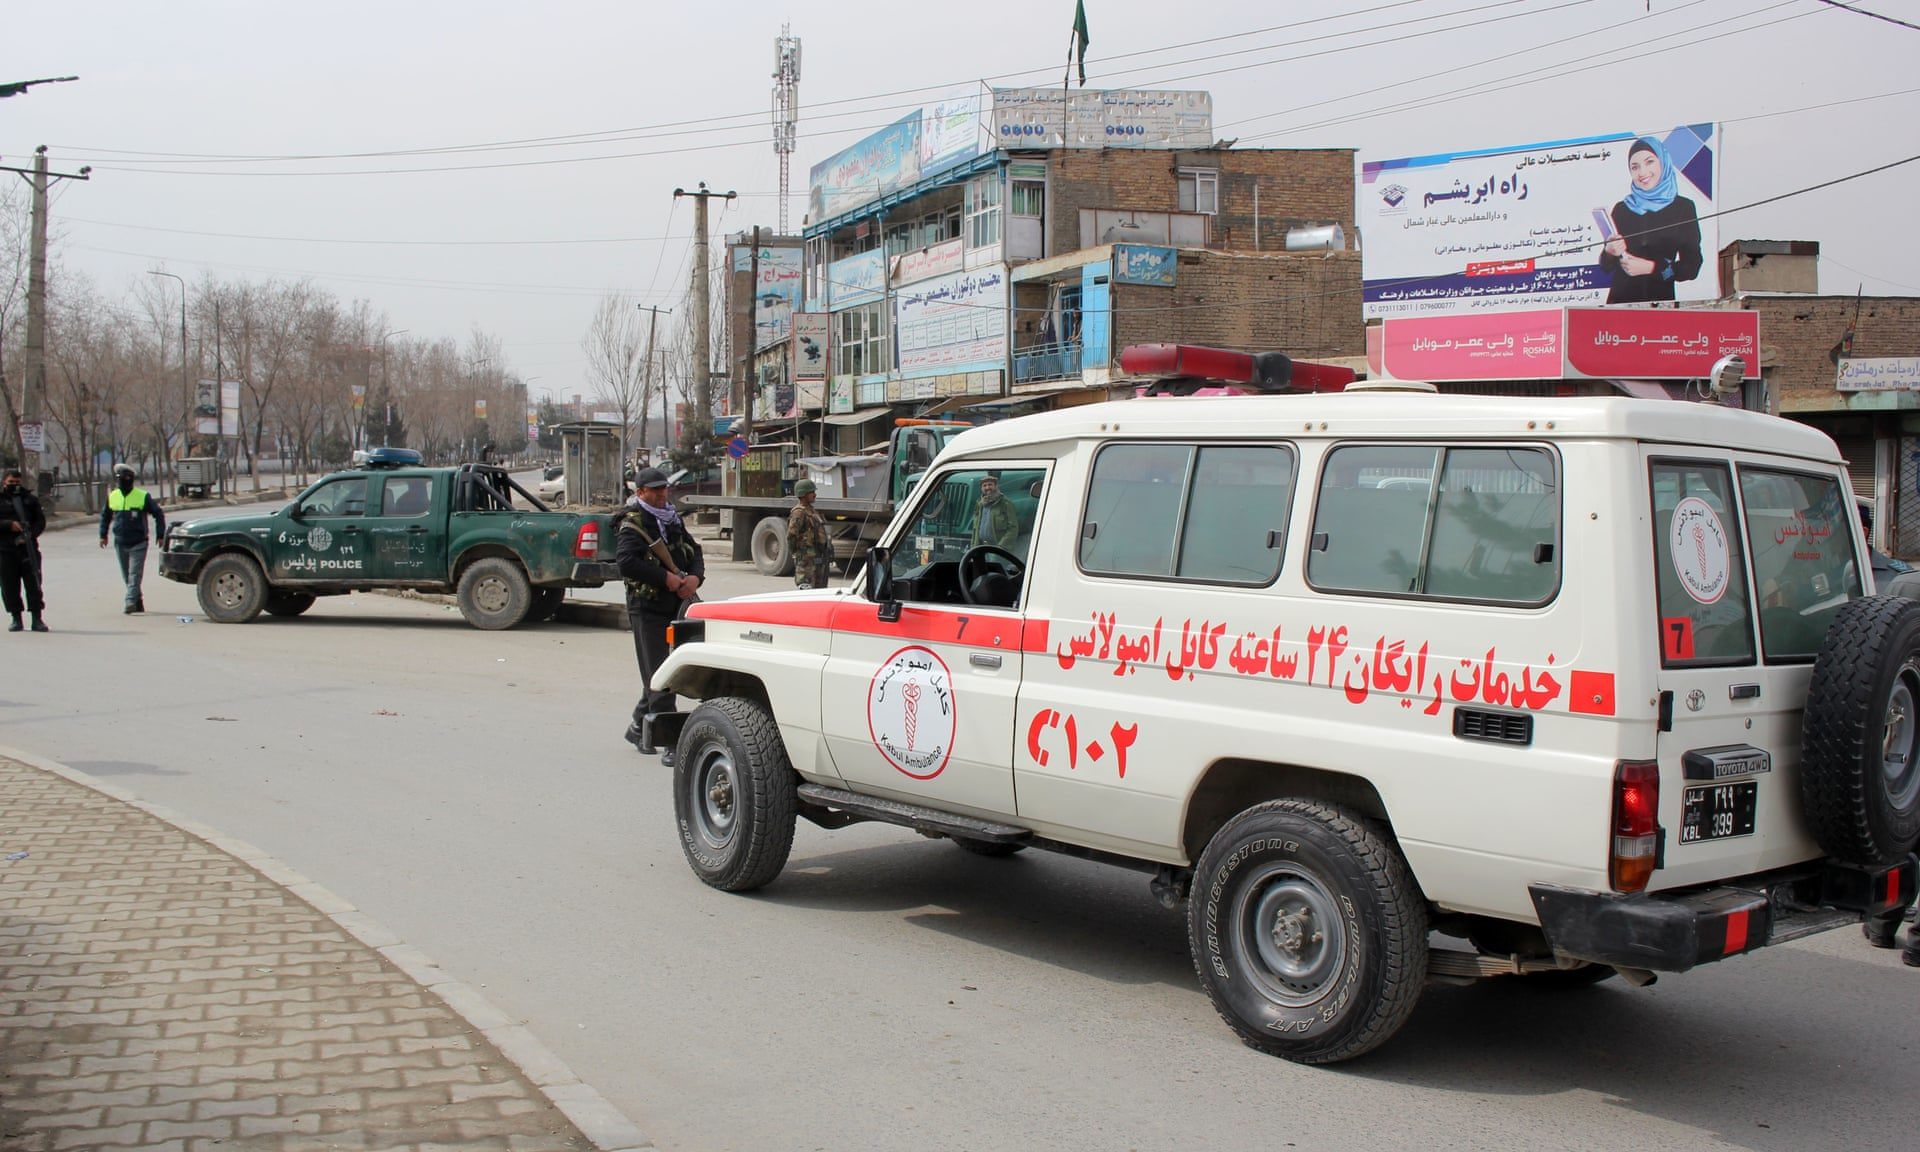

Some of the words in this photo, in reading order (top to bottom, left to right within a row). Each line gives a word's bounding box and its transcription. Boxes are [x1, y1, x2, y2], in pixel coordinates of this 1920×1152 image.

[1515, 156, 1536, 169] عالی
[1424, 175, 1495, 208] ابریشم
[1500, 173, 1528, 200] راه
[1440, 213, 1457, 226] عالی
[1458, 211, 1501, 225] دارالمعلمین
[1130, 252, 1161, 267] مهاجر
[1412, 337, 1452, 351] موبایل
[1454, 337, 1484, 349] عصر
[1487, 333, 1514, 349] ولی
[1522, 331, 1556, 345] روشن
[1594, 330, 1637, 345] موبایل
[1640, 334, 1679, 346] عصر
[1682, 331, 1709, 347] ولی
[1718, 332, 1752, 346] روشن
[1522, 346, 1556, 356] ROSHAN
[1718, 346, 1753, 355] ROSHAN
[282, 553, 317, 572] پولیس
[320, 559, 363, 569] POLICE
[955, 617, 969, 640] 7
[1057, 610, 1163, 677] امبولانس
[1669, 622, 1684, 655] 7
[1166, 618, 1227, 682] کابل
[1229, 623, 1298, 682] ساعته
[1306, 623, 1349, 689] ۲۴
[1344, 634, 1444, 716] رایگان
[1450, 645, 1562, 711] خدمات
[930, 674, 951, 716] کابل
[881, 733, 904, 763] Kabul
[904, 745, 942, 769] Ambulance
[1064, 713, 1139, 779] ۱۰۲
[1716, 761, 1747, 776] TOYOTA
[1748, 759, 1768, 772] 4WD
[1683, 824, 1701, 841] KBL
[1711, 812, 1733, 837] 399
[1206, 838, 1300, 979] BRIDGESTONE
